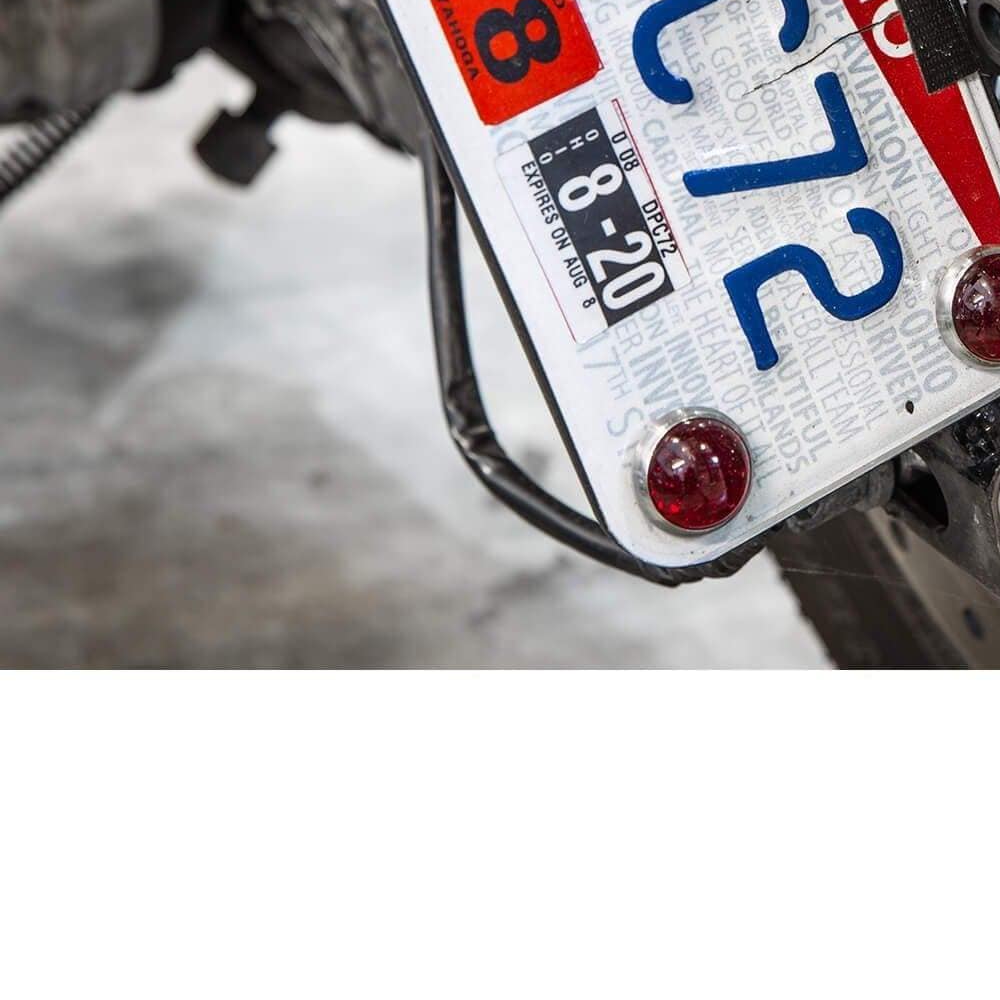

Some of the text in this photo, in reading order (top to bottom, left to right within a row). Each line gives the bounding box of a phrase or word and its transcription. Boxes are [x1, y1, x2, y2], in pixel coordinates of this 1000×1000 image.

[834, 31, 920, 191] AVIATION
[522, 158, 595, 308] EXPIRES ON AUG 8
[640, 200, 677, 257] DPC72
[893, 186, 944, 266] LIGHT
[688, 304, 746, 386] HEART
[864, 323, 930, 417] RIVER
[894, 304, 962, 398] OHIO
[812, 370, 868, 447] TEAM
